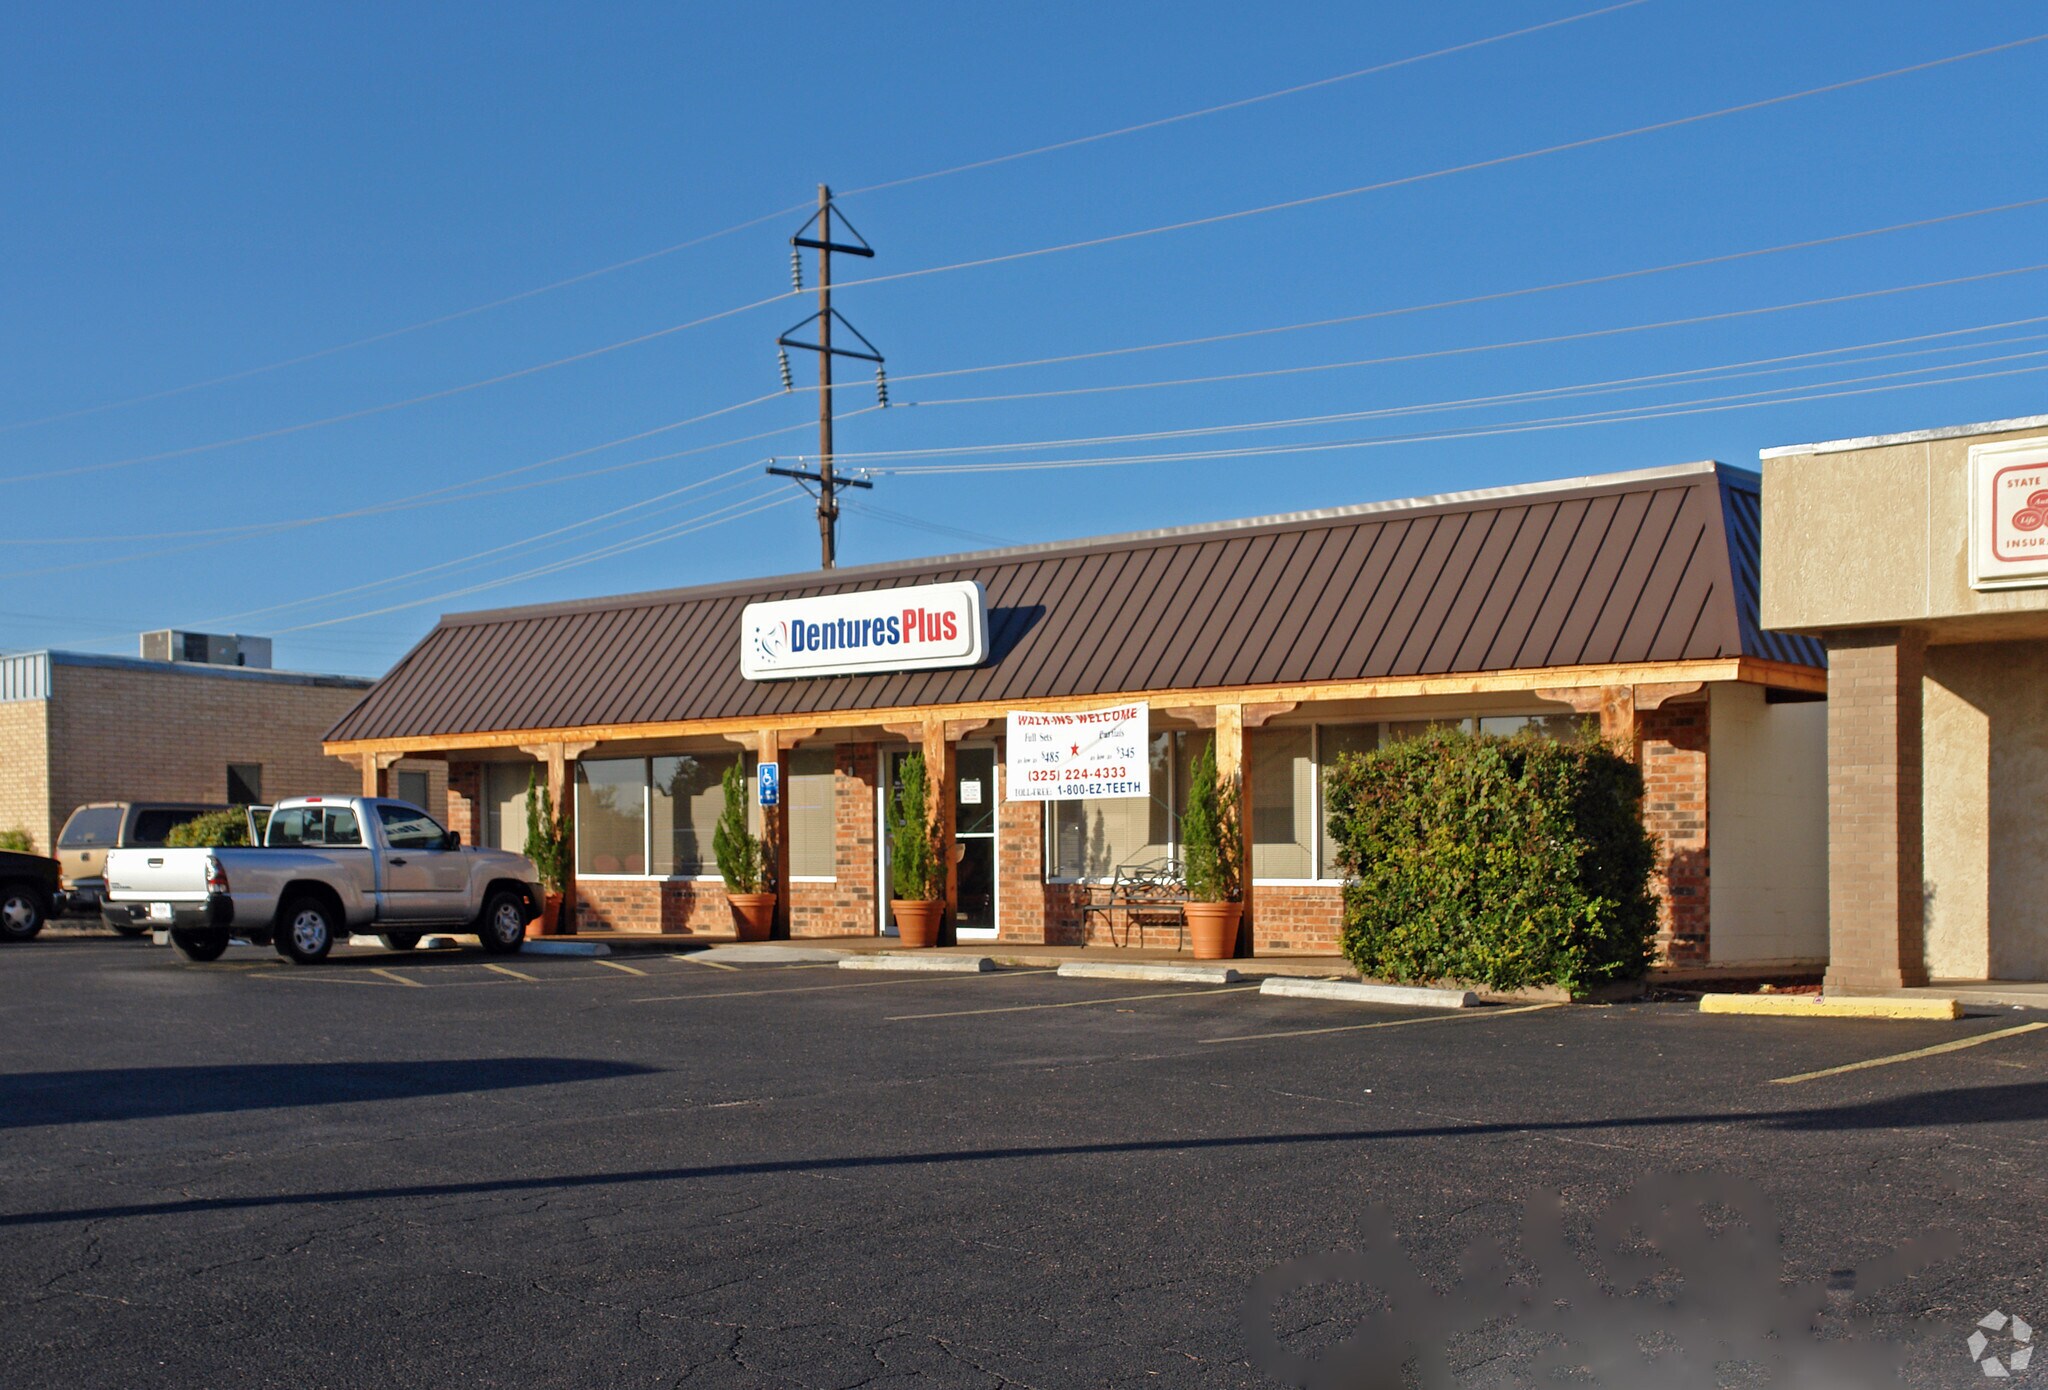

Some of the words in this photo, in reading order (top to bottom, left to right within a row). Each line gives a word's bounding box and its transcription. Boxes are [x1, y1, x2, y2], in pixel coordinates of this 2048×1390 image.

[2007, 476, 2041, 488] STATE
[2020, 516, 2036, 526] Life
[2006, 538, 2048, 548] INSUR
[1018, 715, 1074, 726] WALK-INS
[1076, 707, 1137, 724] WELCOME
[1024, 732, 1036, 743] Full
[1039, 732, 1053, 742] Sets
[1041, 751, 1060, 763] $485
[1116, 747, 1135, 759] $345
[1028, 770, 1060, 782] (325)
[1065, 766, 1126, 780] 224-4333
[1057, 781, 1141, 796] 1-800-EZ-TEETH
